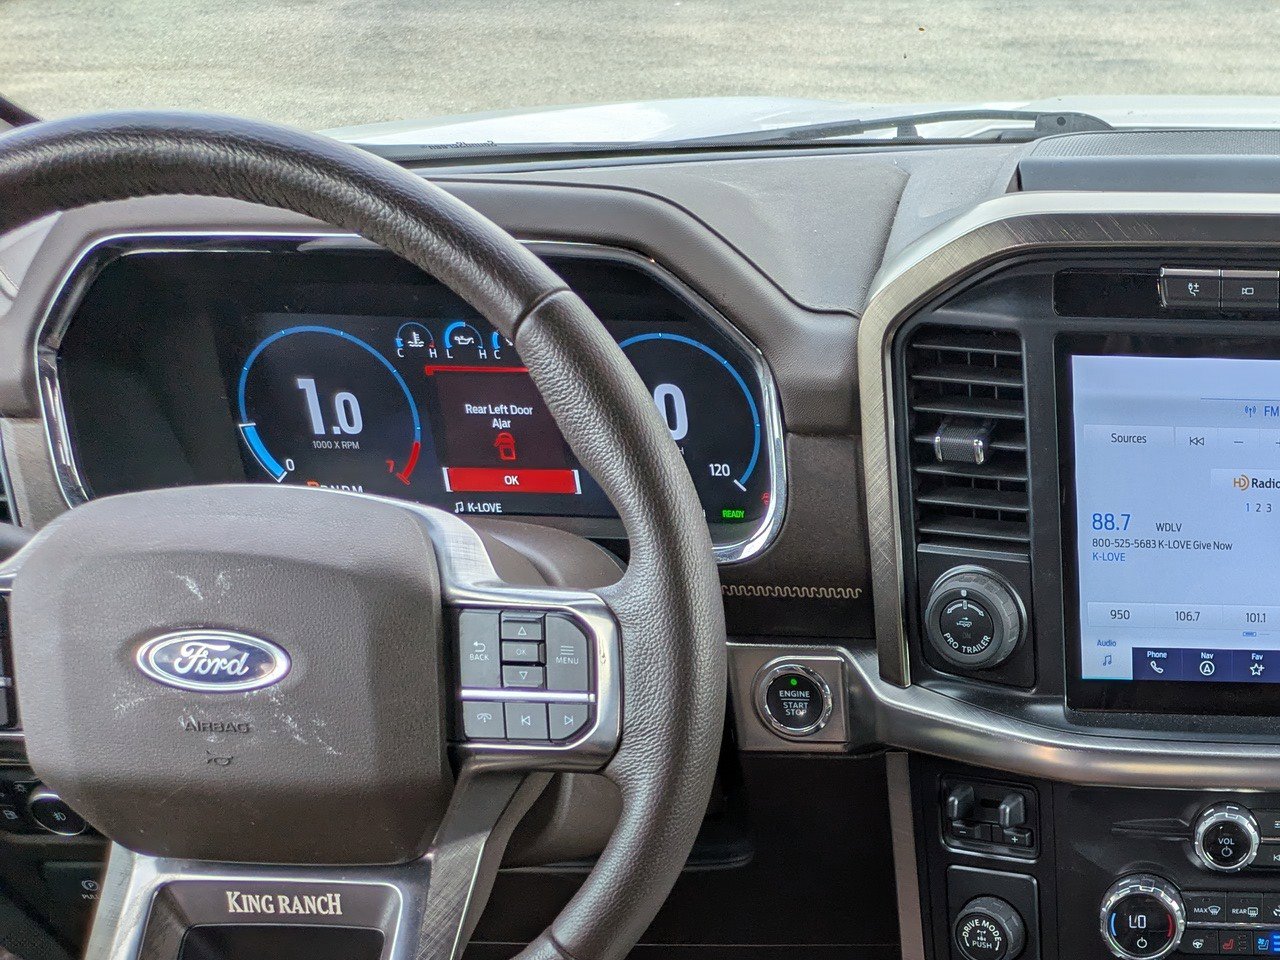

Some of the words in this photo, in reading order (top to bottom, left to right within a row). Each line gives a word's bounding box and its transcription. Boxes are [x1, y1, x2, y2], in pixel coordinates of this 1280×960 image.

[397, 348, 404, 358] C
[429, 348, 438, 358] H
[446, 349, 453, 359] L
[479, 349, 487, 359] H
[297, 378, 363, 435] 1.0
[465, 403, 487, 415] Rear
[488, 404, 508, 415] Left
[510, 405, 533, 415] Door
[1264, 406, 1280, 417] FM
[492, 418, 511, 430] Ajar
[1110, 432, 1147, 444] Sources
[312, 440, 332, 449] 1000
[334, 441, 340, 449] X
[341, 441, 360, 450] RPM
[286, 458, 295, 471] 0
[386, 460, 395, 473] 7
[709, 463, 730, 477] 120
[504, 475, 520, 485] OK
[467, 502, 502, 513] K-LOVE
[1245, 503, 1250, 512] 1
[1255, 503, 1261, 513] 2
[1266, 503, 1272, 513] 3
[722, 509, 745, 518] READY
[1092, 513, 1131, 531] 88.7
[1155, 523, 1182, 532] WDLV
[1092, 538, 1156, 549] 800-525-5683
[1158, 540, 1192, 550] K-LOVE
[1193, 541, 1212, 550] Give
[1213, 541, 1233, 551] Now
[1092, 552, 1126, 562] K-LOVE
[1110, 609, 1131, 620] 950
[1175, 611, 1200, 621] 106.7
[1245, 612, 1266, 623] 101.1
[944, 633, 959, 649] PRO
[962, 635, 991, 654] TRAILER
[1097, 639, 1117, 647] Audio
[174, 642, 249, 676] Ford
[469, 653, 489, 661] BACK
[1147, 651, 1167, 659] Phone
[1201, 651, 1214, 659] Nav
[1251, 653, 1263, 661] Fav
[556, 657, 579, 665] MENU
[779, 690, 810, 698] ENGINE
[184, 721, 250, 733] AIRBAG
[1218, 837, 1235, 845] VOL
[226, 890, 273, 914] KING
[278, 892, 343, 916] RANCH
[962, 919, 980, 938] DRIVE
[981, 920, 1002, 941] MODE
[972, 940, 993, 949] PUSH
